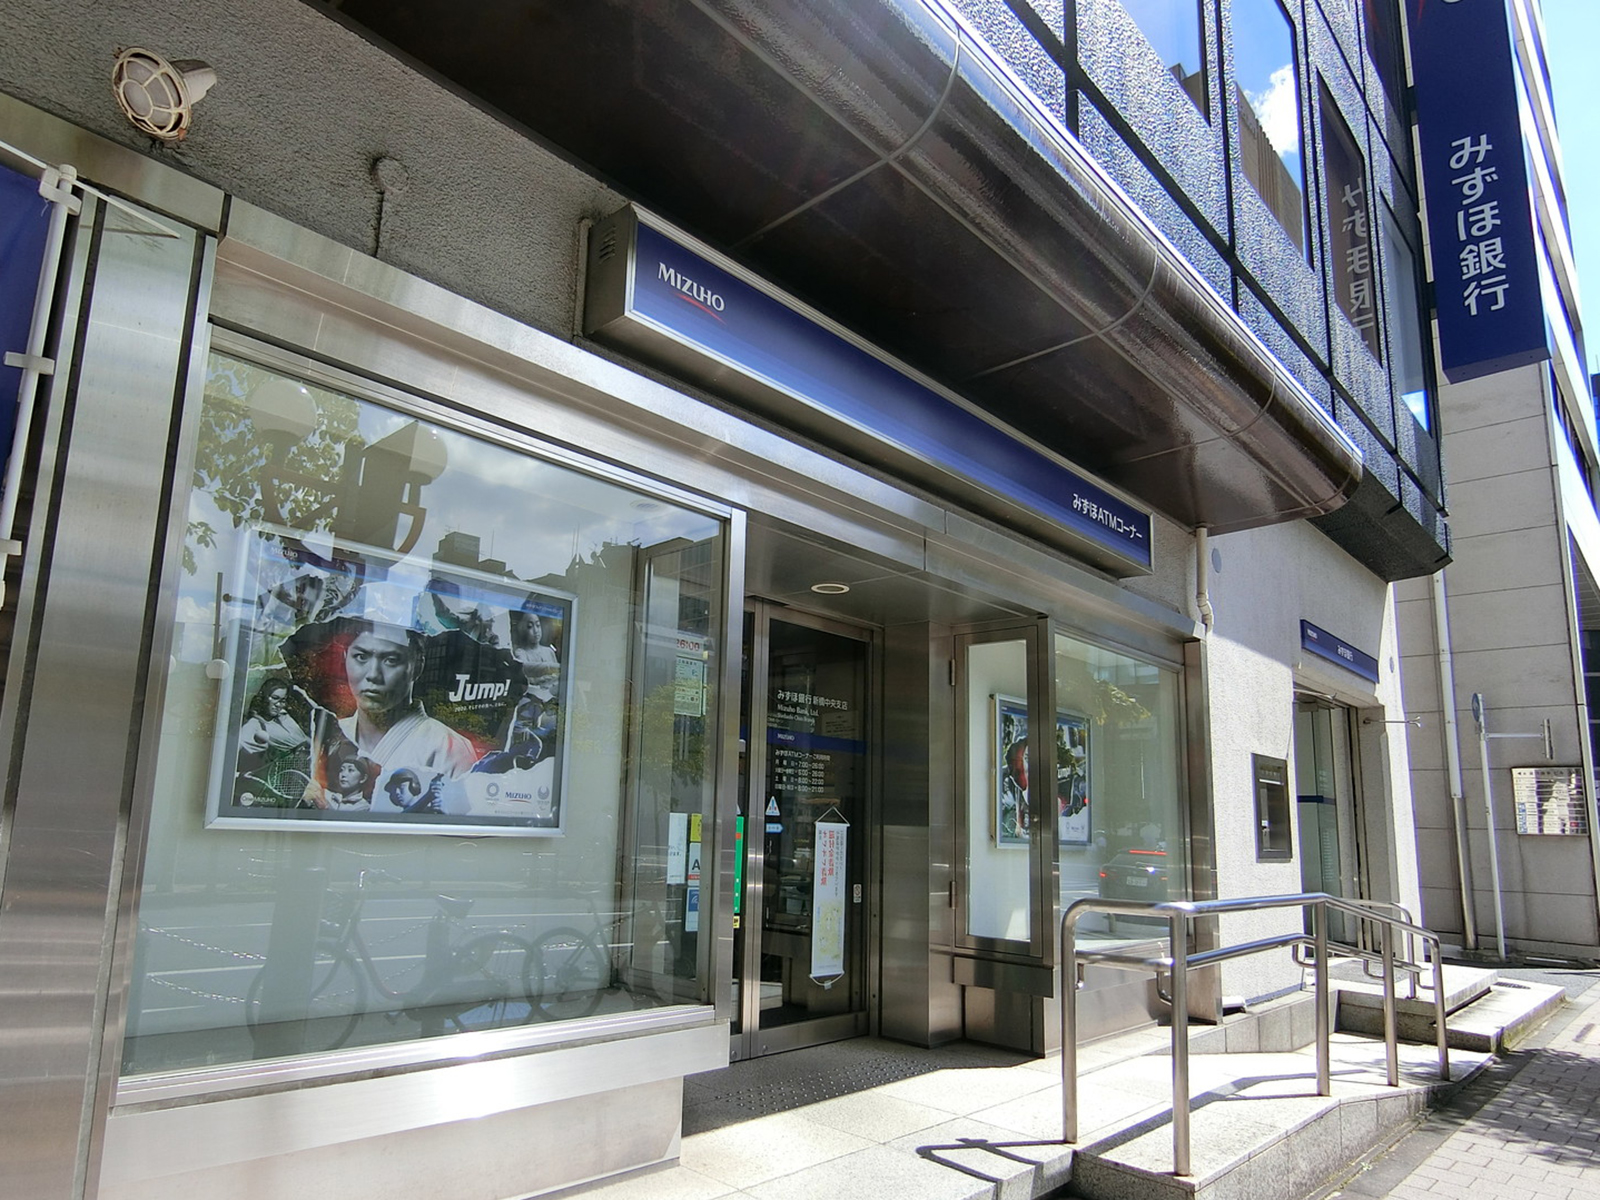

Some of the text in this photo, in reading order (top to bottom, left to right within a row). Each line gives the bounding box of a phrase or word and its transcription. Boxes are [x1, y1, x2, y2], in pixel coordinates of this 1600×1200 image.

[1450, 133, 1510, 317] みずほ銀行
[658, 262, 725, 312] MIZUHO
[1072, 493, 1143, 539] みずほATMコーナー
[449, 673, 511, 702] Jump!
[505, 791, 532, 800] MIZUHO
